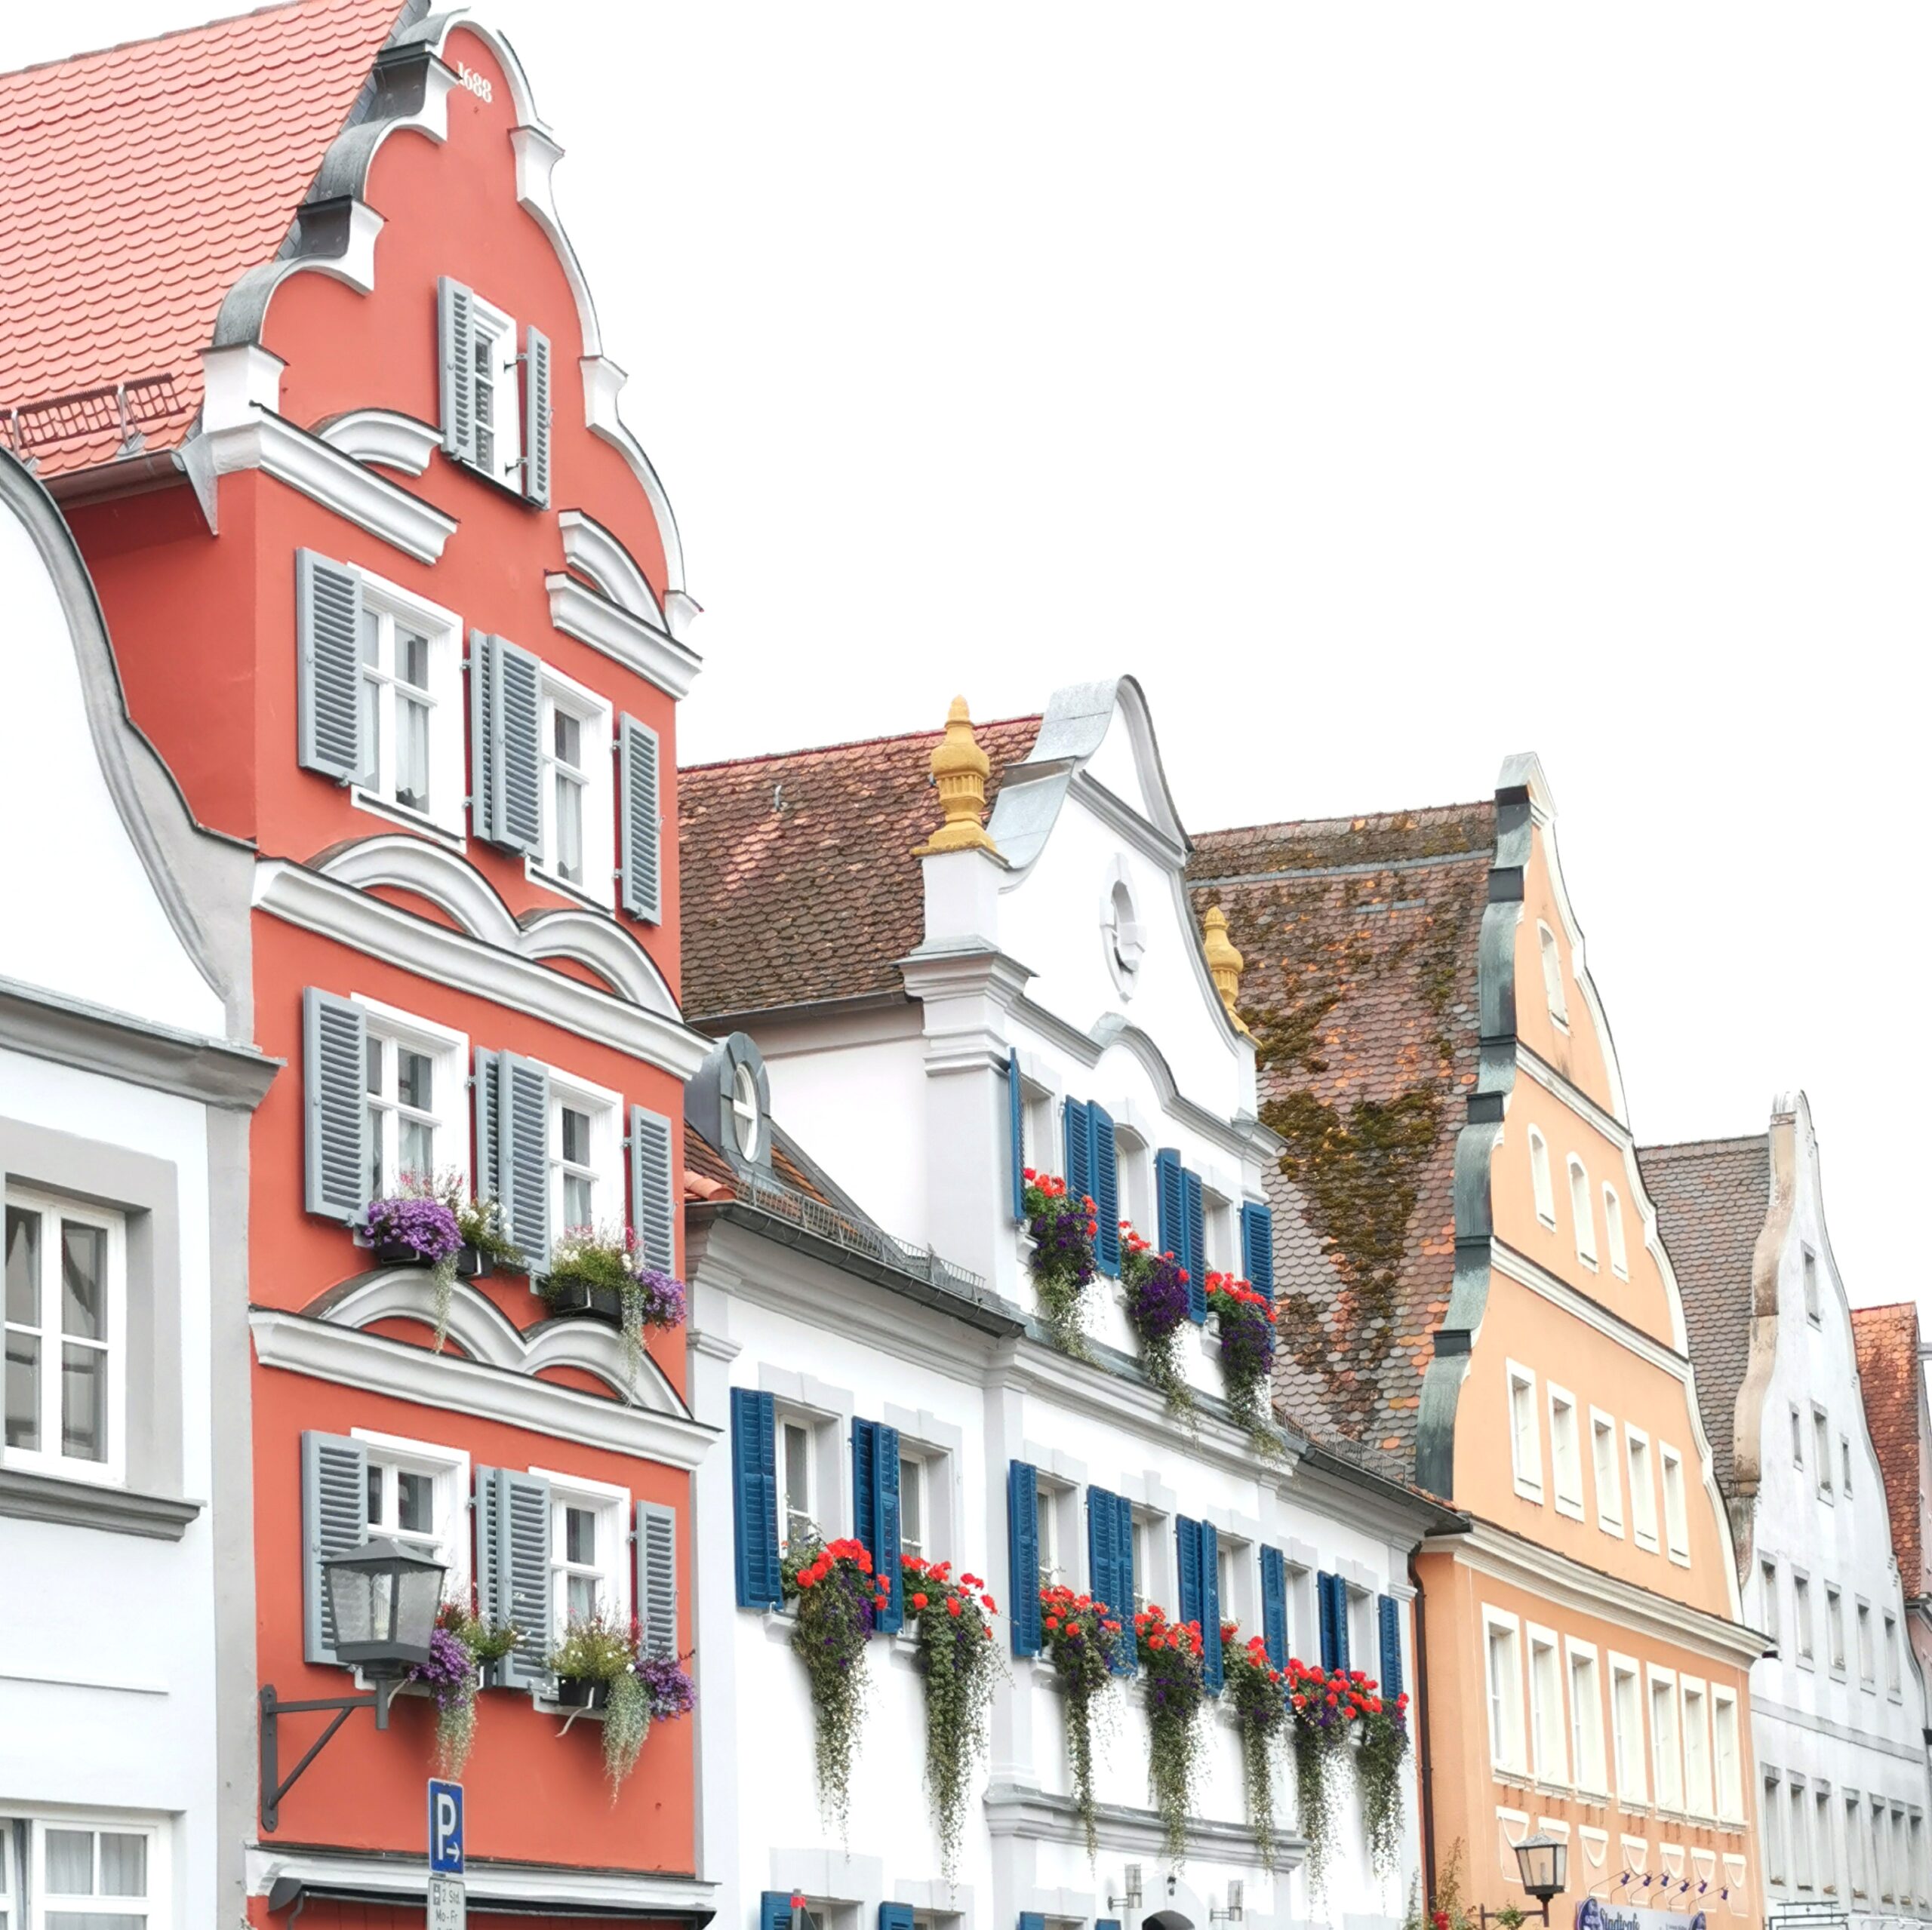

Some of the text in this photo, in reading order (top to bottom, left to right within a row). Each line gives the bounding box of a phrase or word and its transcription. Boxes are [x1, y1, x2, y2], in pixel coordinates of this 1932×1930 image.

[457, 60, 493, 103] 1688
[438, 1793, 457, 1861] P
[442, 1889, 447, 1902] 2
